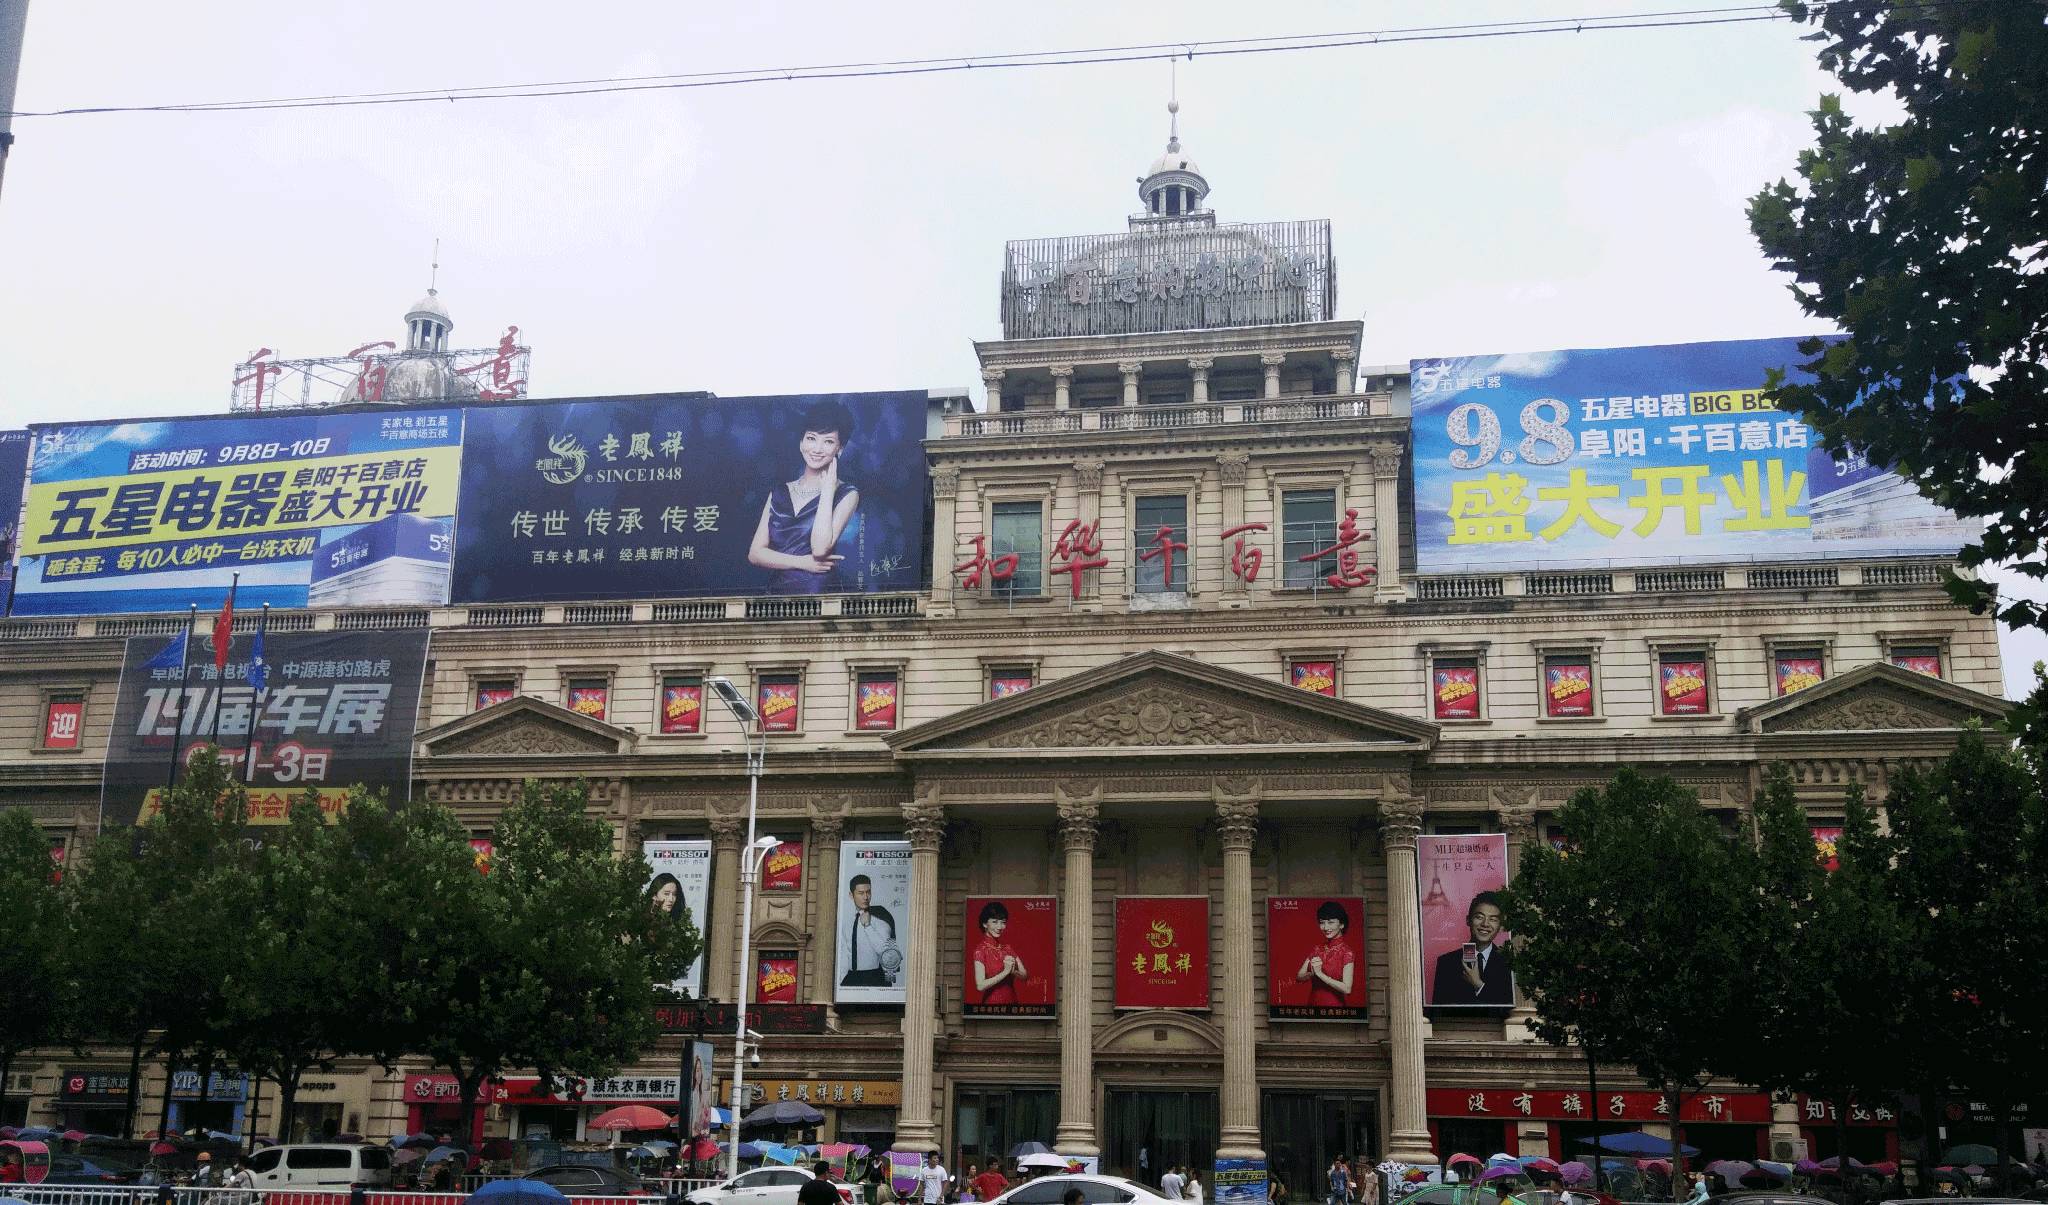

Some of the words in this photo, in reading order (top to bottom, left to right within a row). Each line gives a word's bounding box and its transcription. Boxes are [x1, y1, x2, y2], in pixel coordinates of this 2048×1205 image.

[233, 326, 527, 414] 千百意
[1580, 393, 1687, 421] 五星电器
[1694, 395, 1731, 413] BIG
[218, 437, 331, 463] 9月8日-10日
[1446, 399, 1575, 469] 9.8
[290, 457, 428, 488] 阜阳千百意店
[37, 470, 287, 544] 五星电器
[274, 481, 429, 524] 盛大开业
[1446, 459, 1812, 545] 盛大开业
[511, 509, 570, 538] 传世
[584, 507, 644, 536] 传承
[661, 504, 720, 533] 传爱
[116, 536, 314, 571] 每10人必中一台洗衣机
[619, 546, 695, 562] 经典新时尚
[282, 660, 391, 680] 中源捷豹路虎
[51, 712, 77, 739] 迎
[496, 1088, 509, 1099] 24
